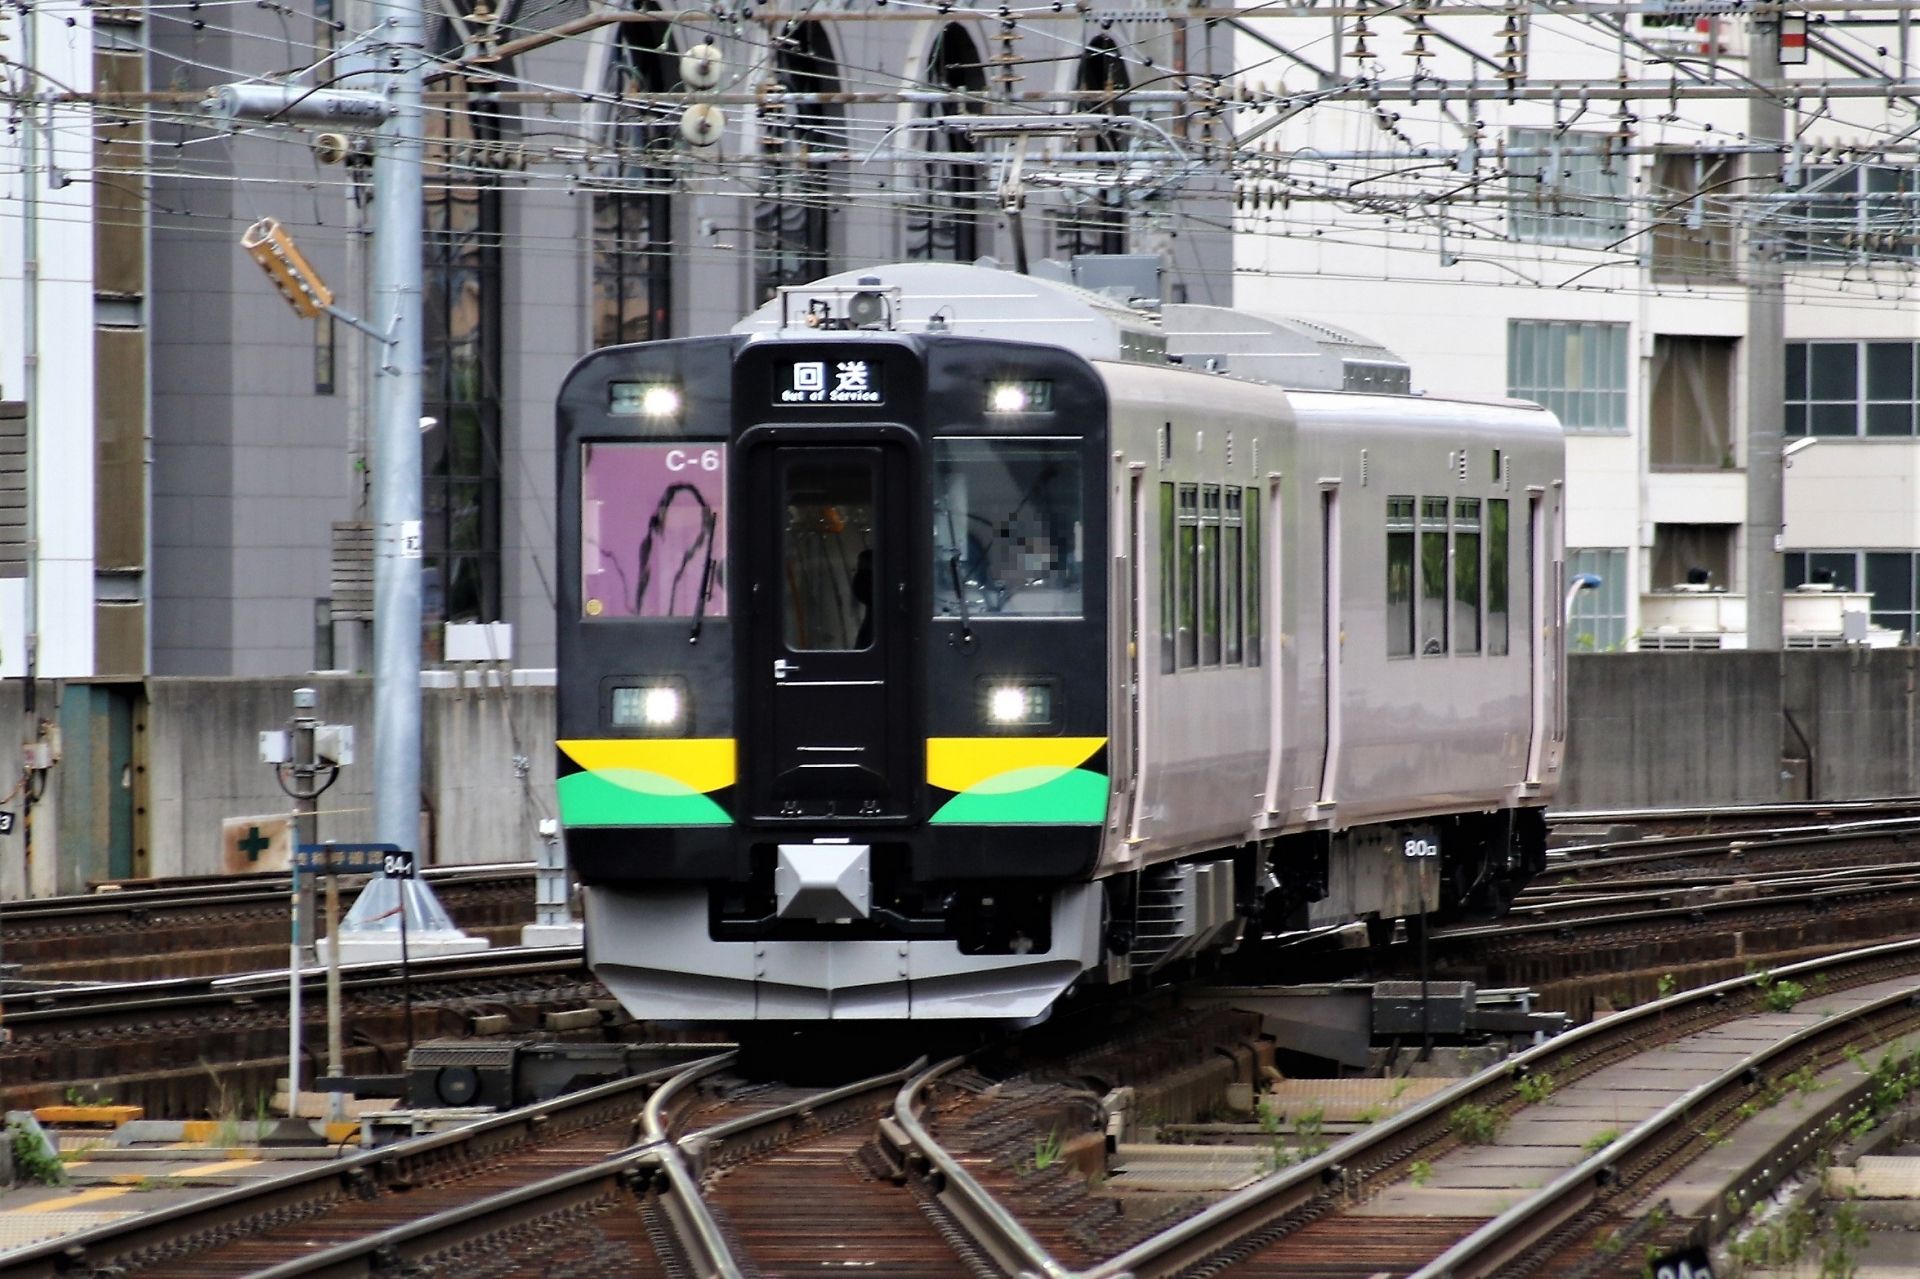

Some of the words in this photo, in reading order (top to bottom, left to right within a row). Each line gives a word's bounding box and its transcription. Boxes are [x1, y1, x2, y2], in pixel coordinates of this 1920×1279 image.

[793, 361, 868, 391] 回送
[781, 389, 804, 402] Out
[809, 389, 826, 402] of
[829, 389, 879, 402] Service
[665, 449, 720, 472] C-6
